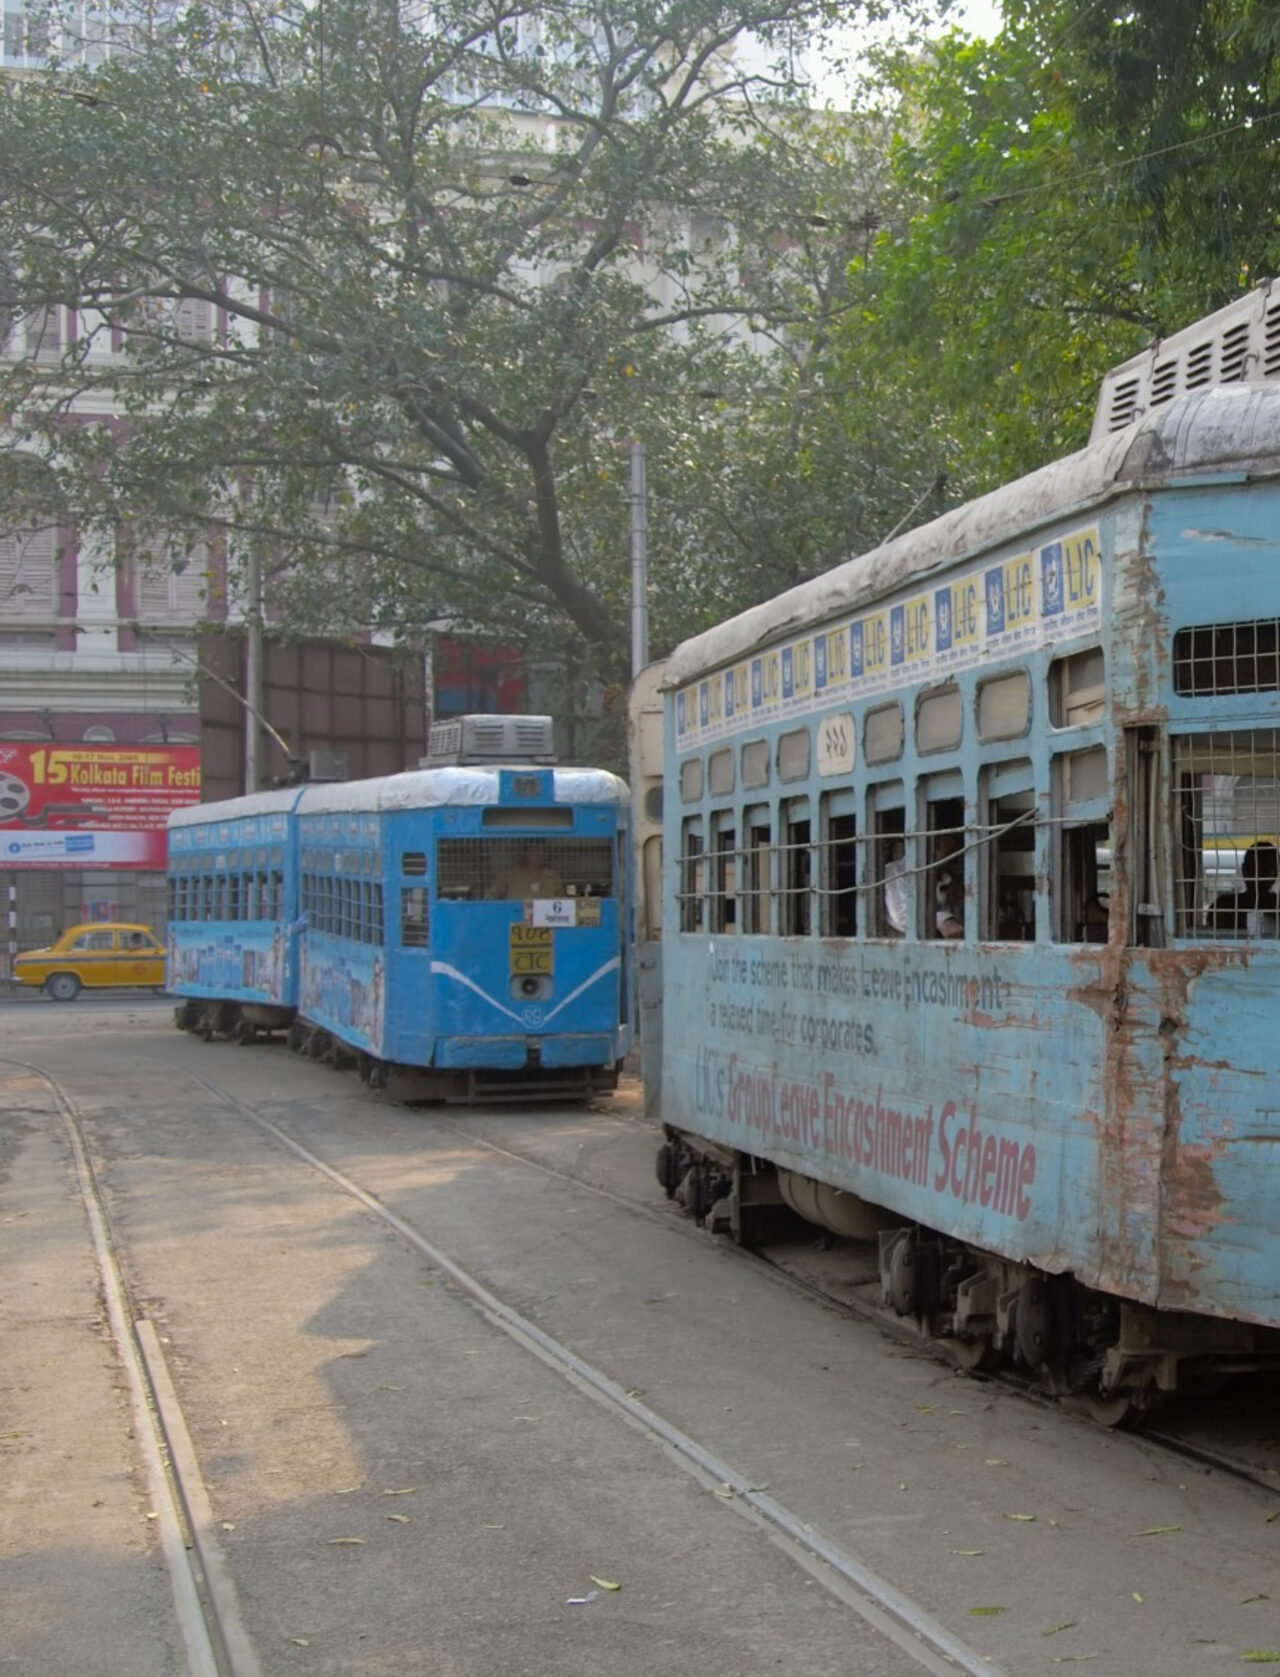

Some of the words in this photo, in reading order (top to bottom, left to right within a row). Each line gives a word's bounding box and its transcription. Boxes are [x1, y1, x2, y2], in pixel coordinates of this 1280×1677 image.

[1006, 562, 1032, 621] LIC
[1066, 538, 1094, 602] LIC
[906, 603, 928, 654] LIC
[953, 584, 976, 639] LIC
[865, 619, 884, 667] LIC
[29, 749, 67, 784] 15
[70, 764, 127, 785] Kolkata
[132, 766, 163, 785] Film
[553, 901, 562, 914] 6
[515, 951, 549, 970] CTC
[817, 955, 857, 996] makes
[861, 953, 902, 1000] Leave
[904, 953, 1002, 1010] Encashment
[728, 1053, 771, 1143] Group
[771, 1061, 819, 1149] Leave
[824, 1071, 933, 1187] Encashment
[934, 1100, 1035, 1221] Scheme
